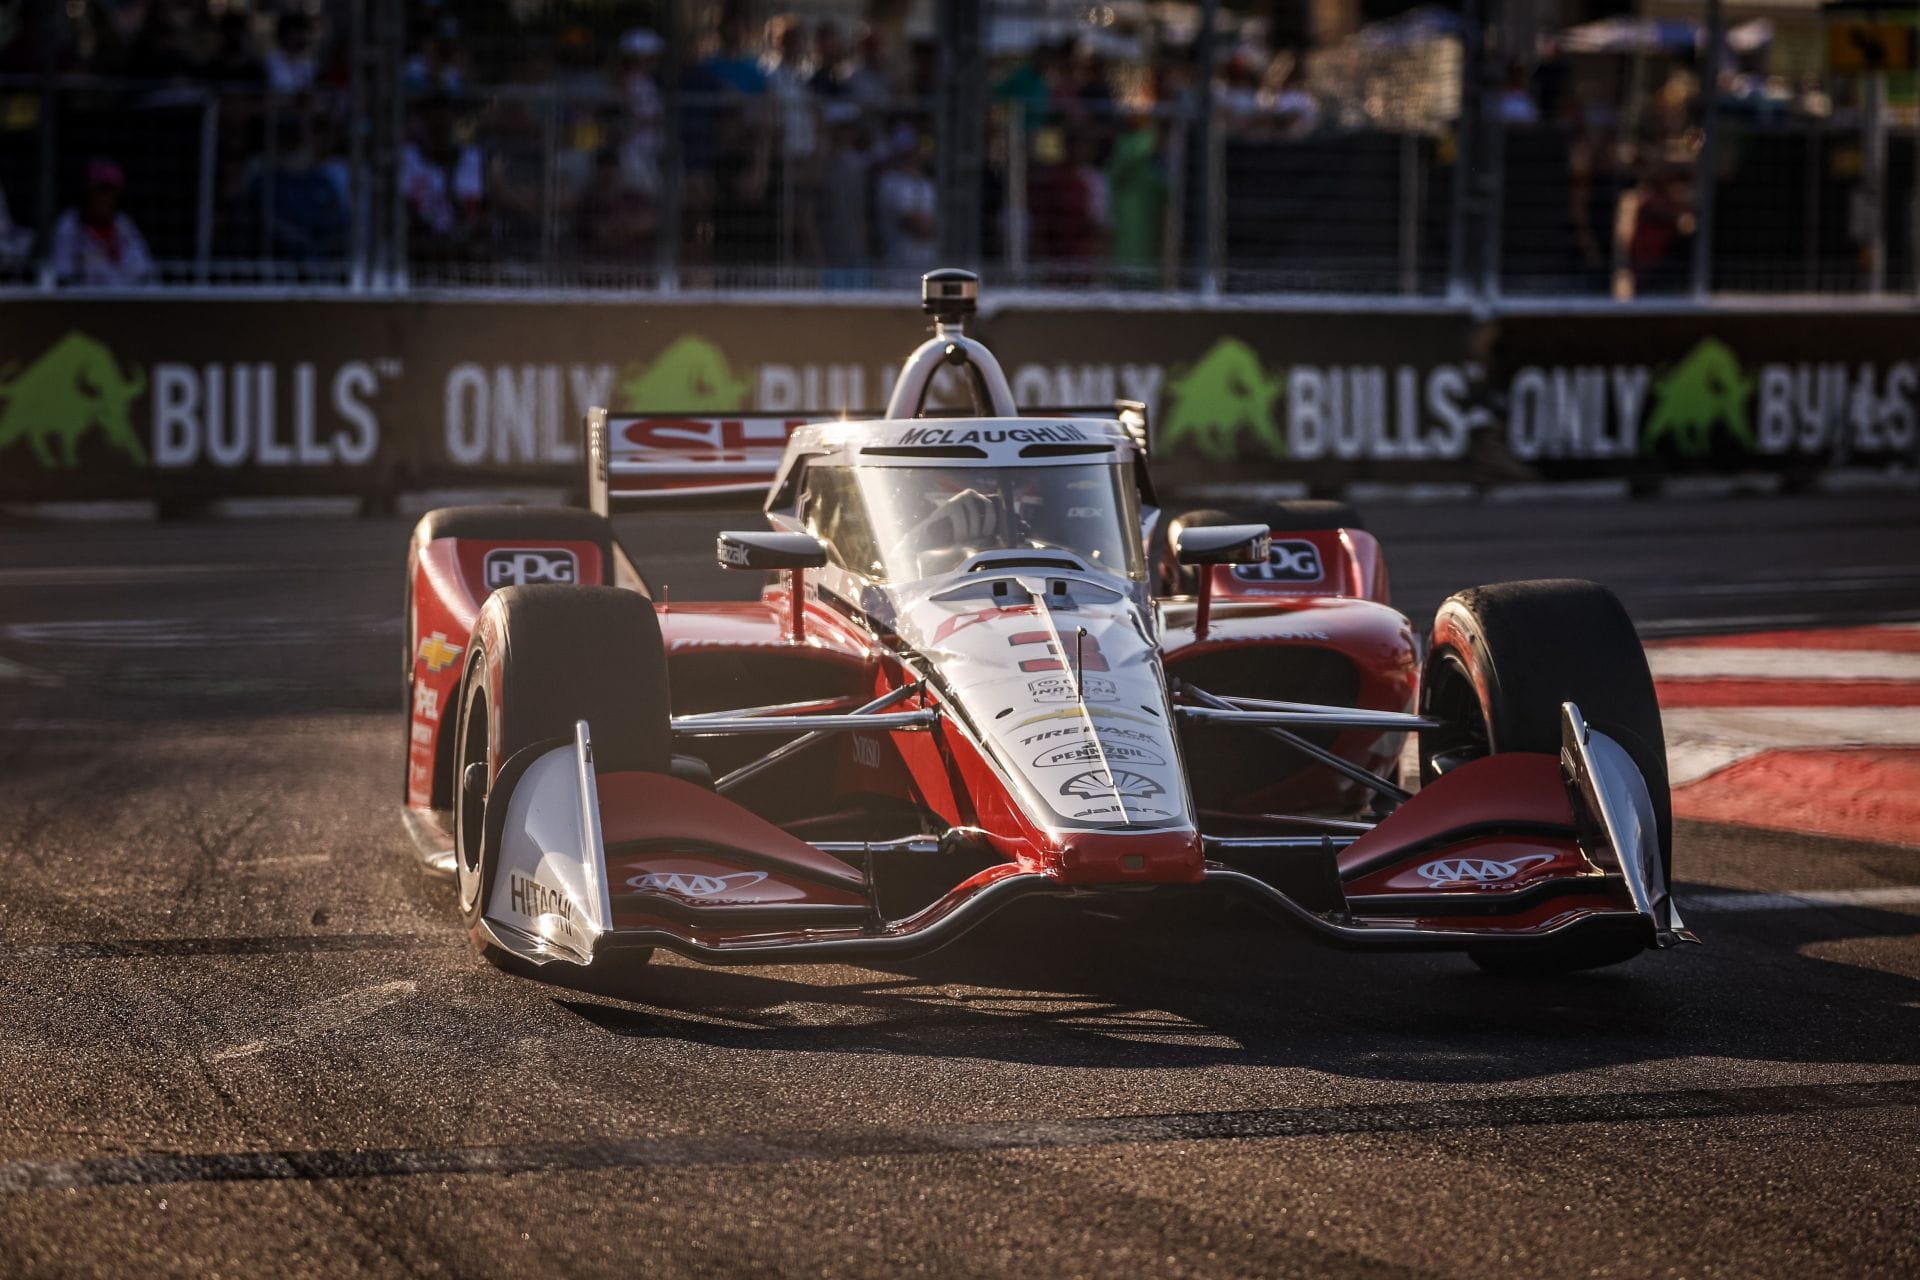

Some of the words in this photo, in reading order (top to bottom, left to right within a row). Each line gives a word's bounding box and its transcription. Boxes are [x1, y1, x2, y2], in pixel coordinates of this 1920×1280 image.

[1509, 366, 1651, 458] ONLY
[899, 424, 1088, 445] MCLAUGHLIN
[1237, 545, 1316, 579] PG
[1431, 859, 1509, 881] AAA
[640, 873, 713, 895] AAA
